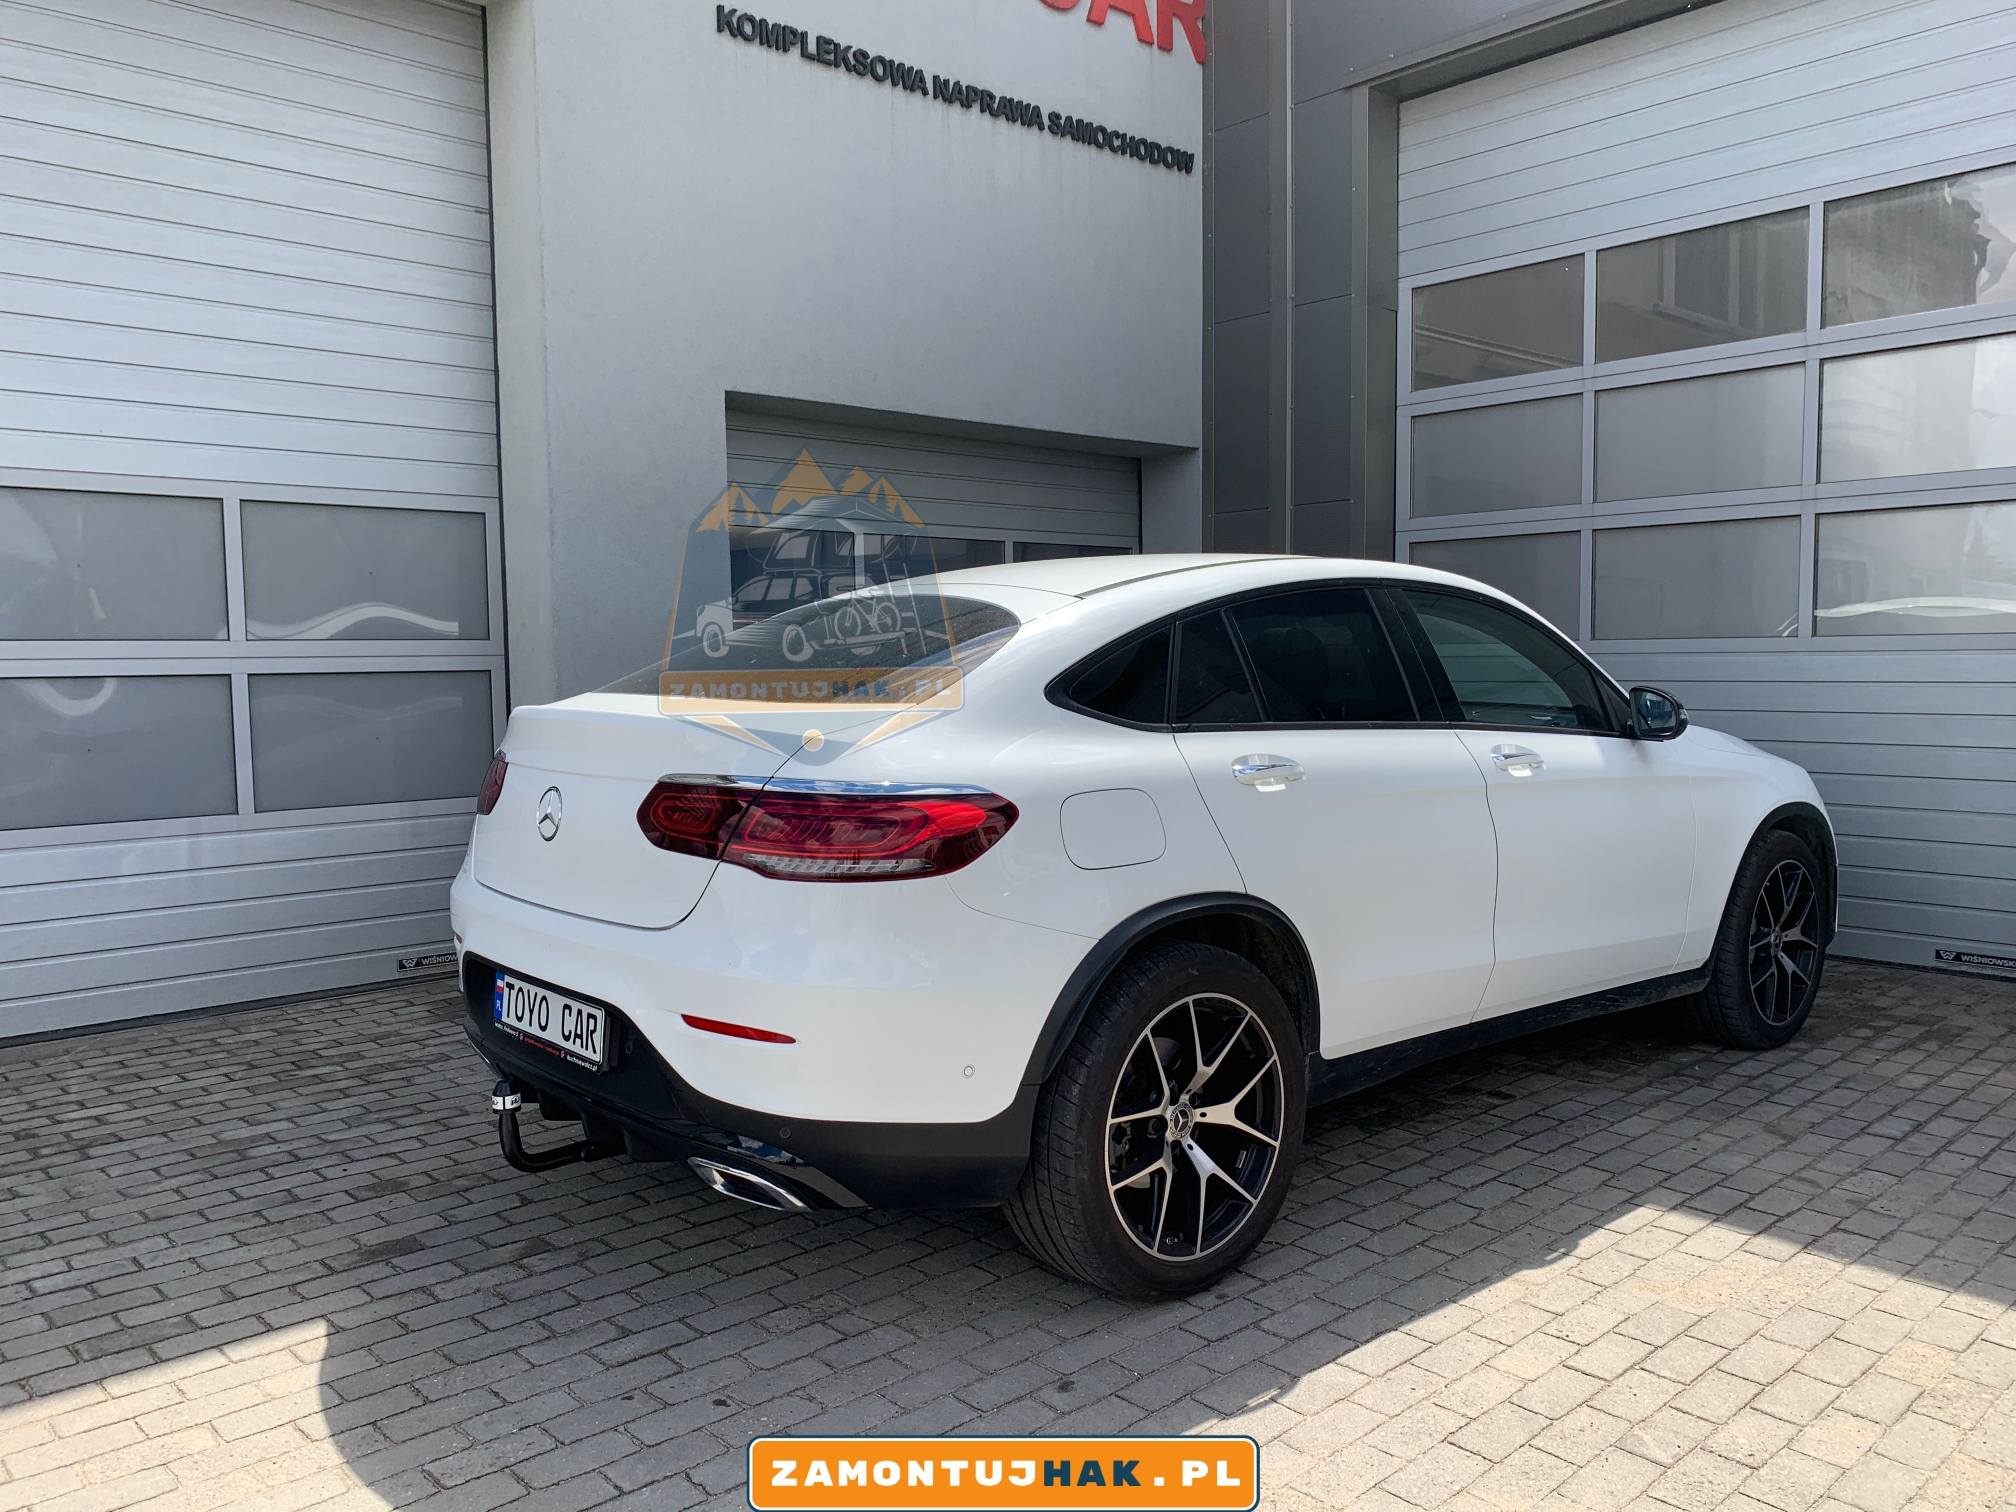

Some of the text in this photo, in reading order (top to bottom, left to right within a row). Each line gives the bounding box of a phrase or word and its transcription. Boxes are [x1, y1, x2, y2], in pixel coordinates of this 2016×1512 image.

[715, 4, 1195, 174] KOMPLEKSOWA NAPRAWA SAMOCHODOW
[421, 955, 458, 965] WIŚNIOW
[505, 981, 597, 1055] TOYO CAR
